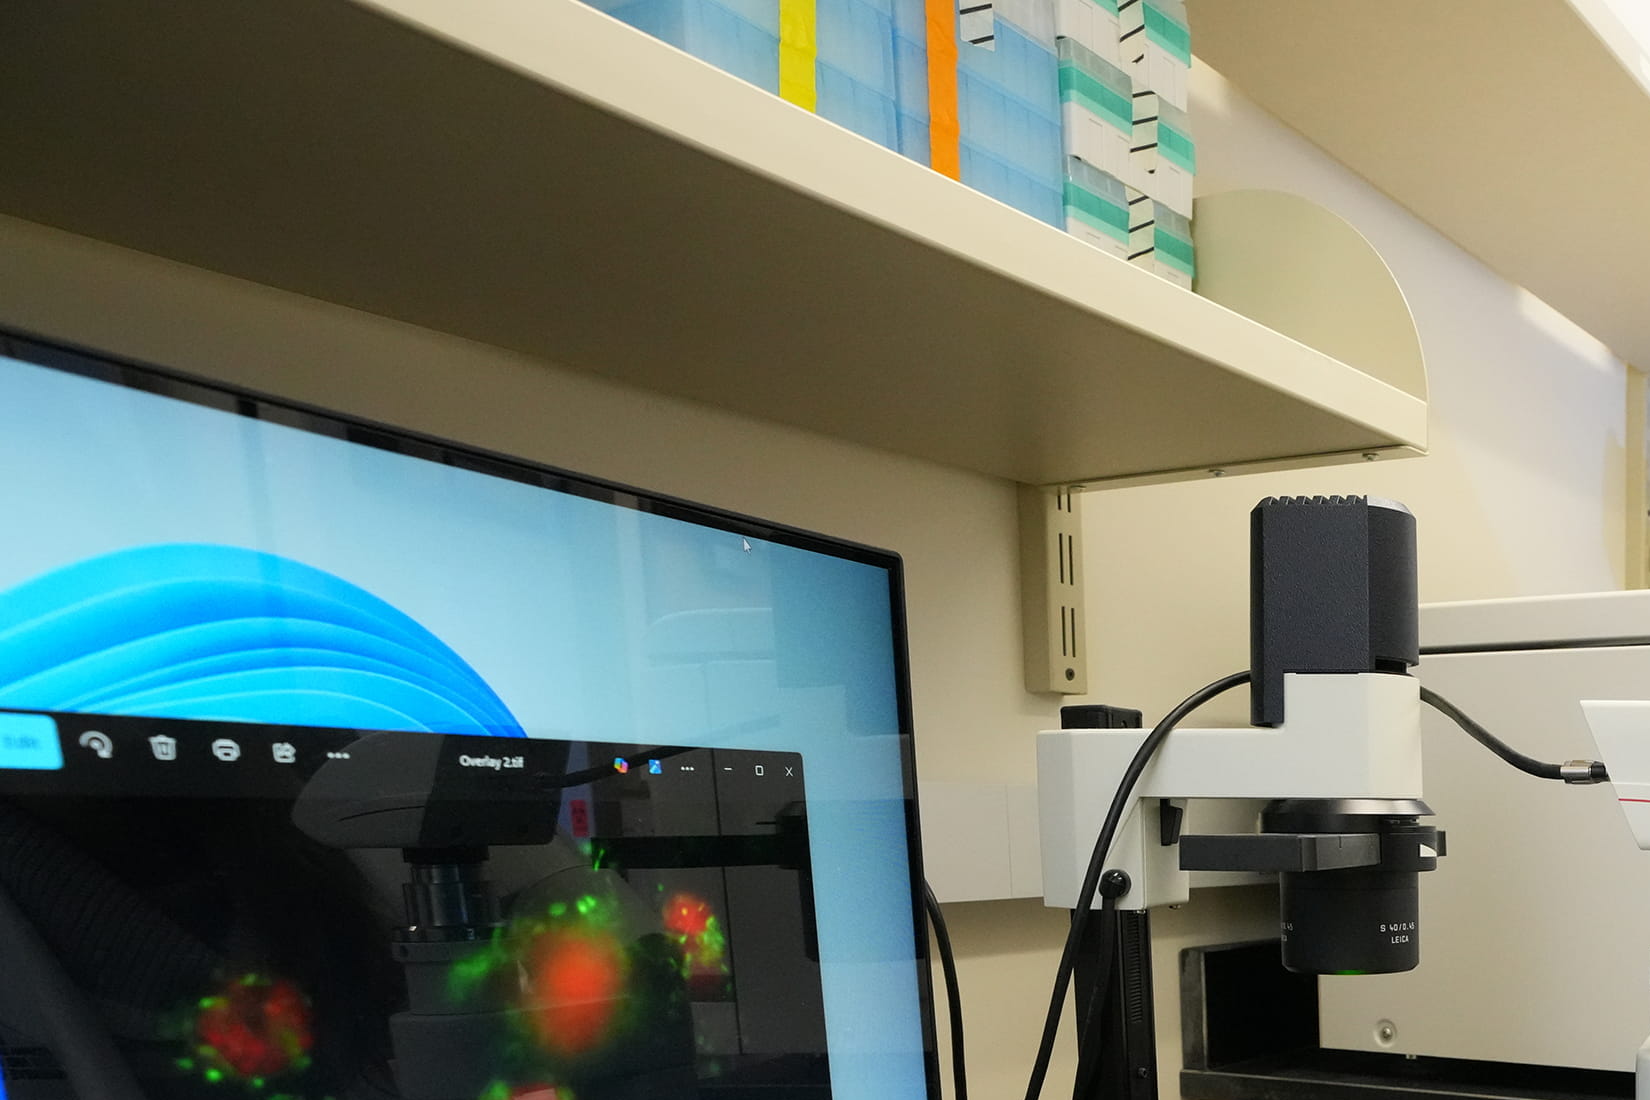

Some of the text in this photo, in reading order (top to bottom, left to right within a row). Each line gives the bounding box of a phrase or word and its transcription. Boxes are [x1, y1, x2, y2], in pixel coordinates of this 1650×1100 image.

[459, 755, 502, 771] Overlay
[1380, 921, 1416, 933] S 40/0.45
[1391, 935, 1409, 944] LEICA
